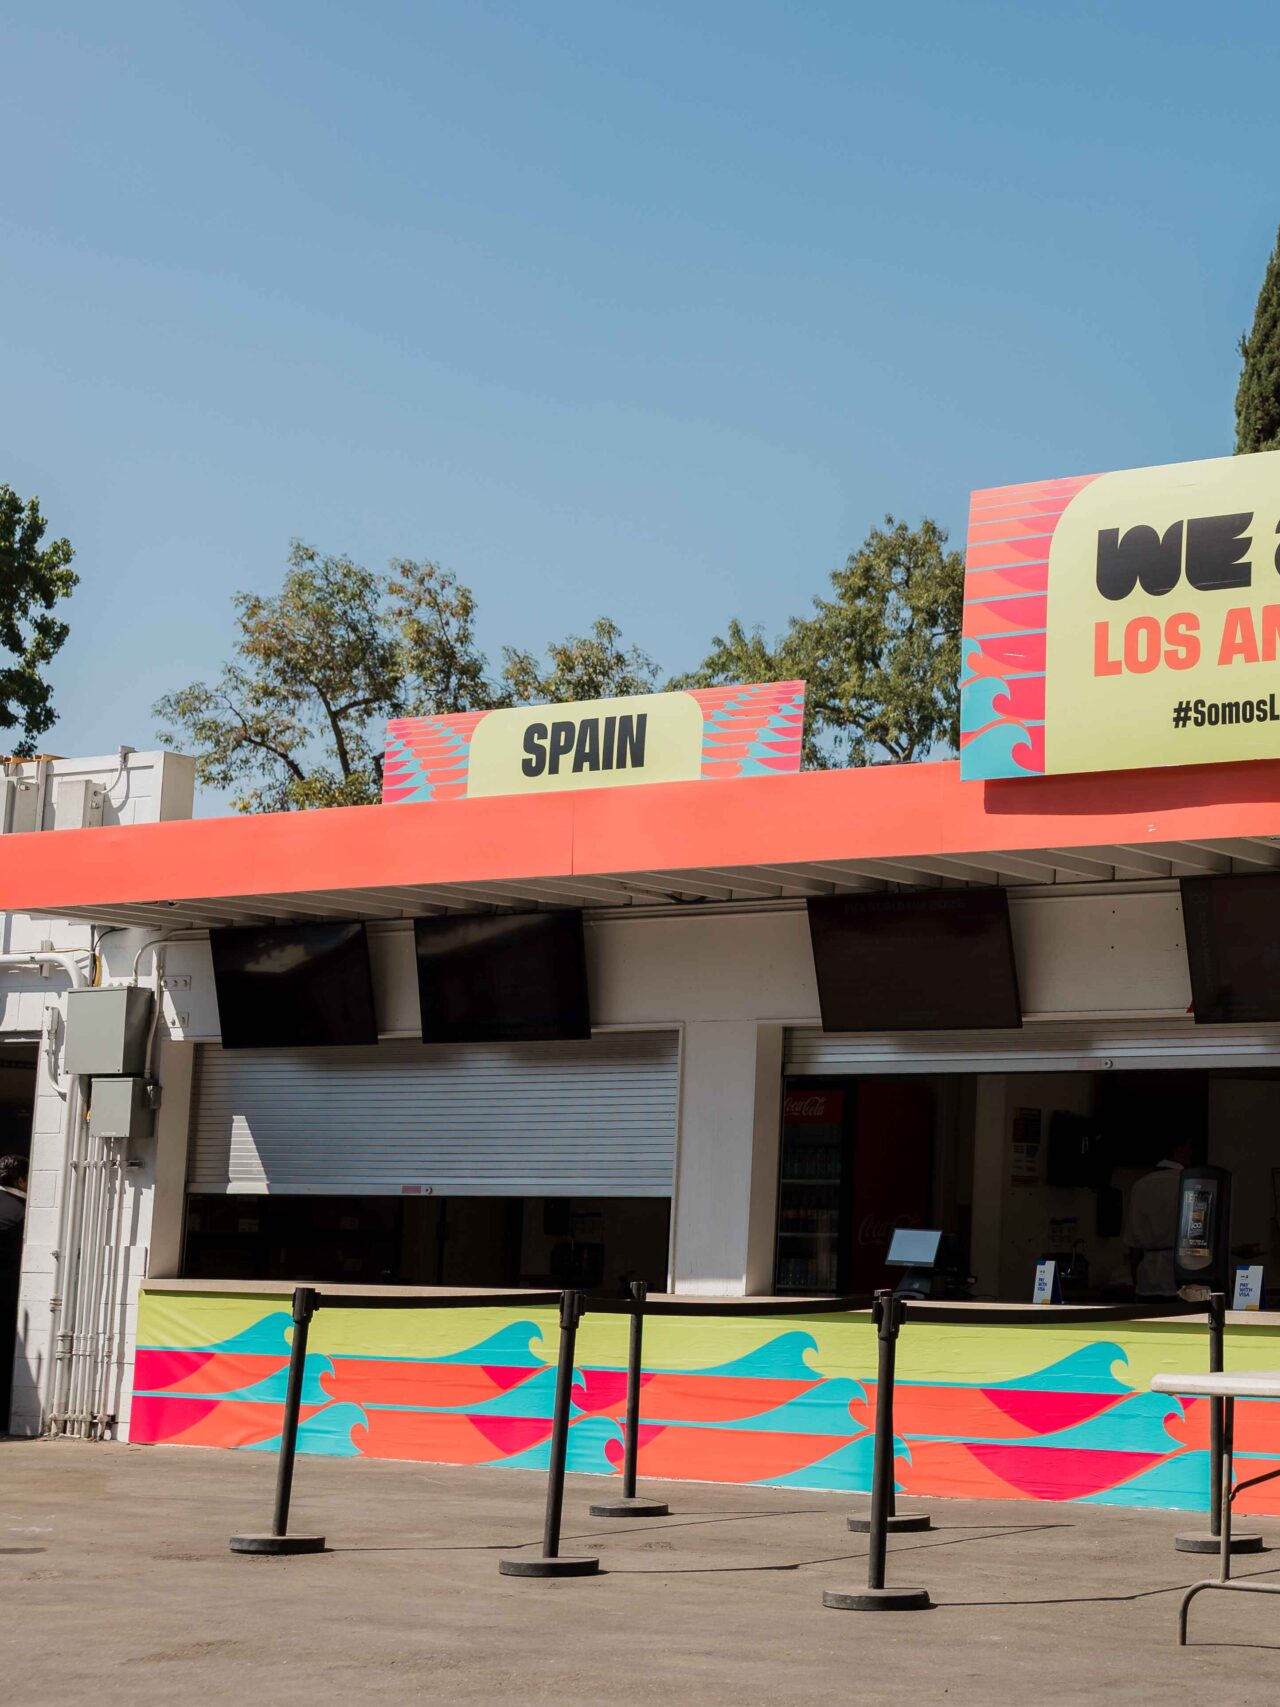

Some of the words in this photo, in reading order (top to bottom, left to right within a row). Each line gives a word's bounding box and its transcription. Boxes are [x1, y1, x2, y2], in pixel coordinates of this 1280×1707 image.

[1096, 511, 1254, 601] WE
[1093, 611, 1201, 677] LOS
[521, 713, 648, 777] SPAIN
